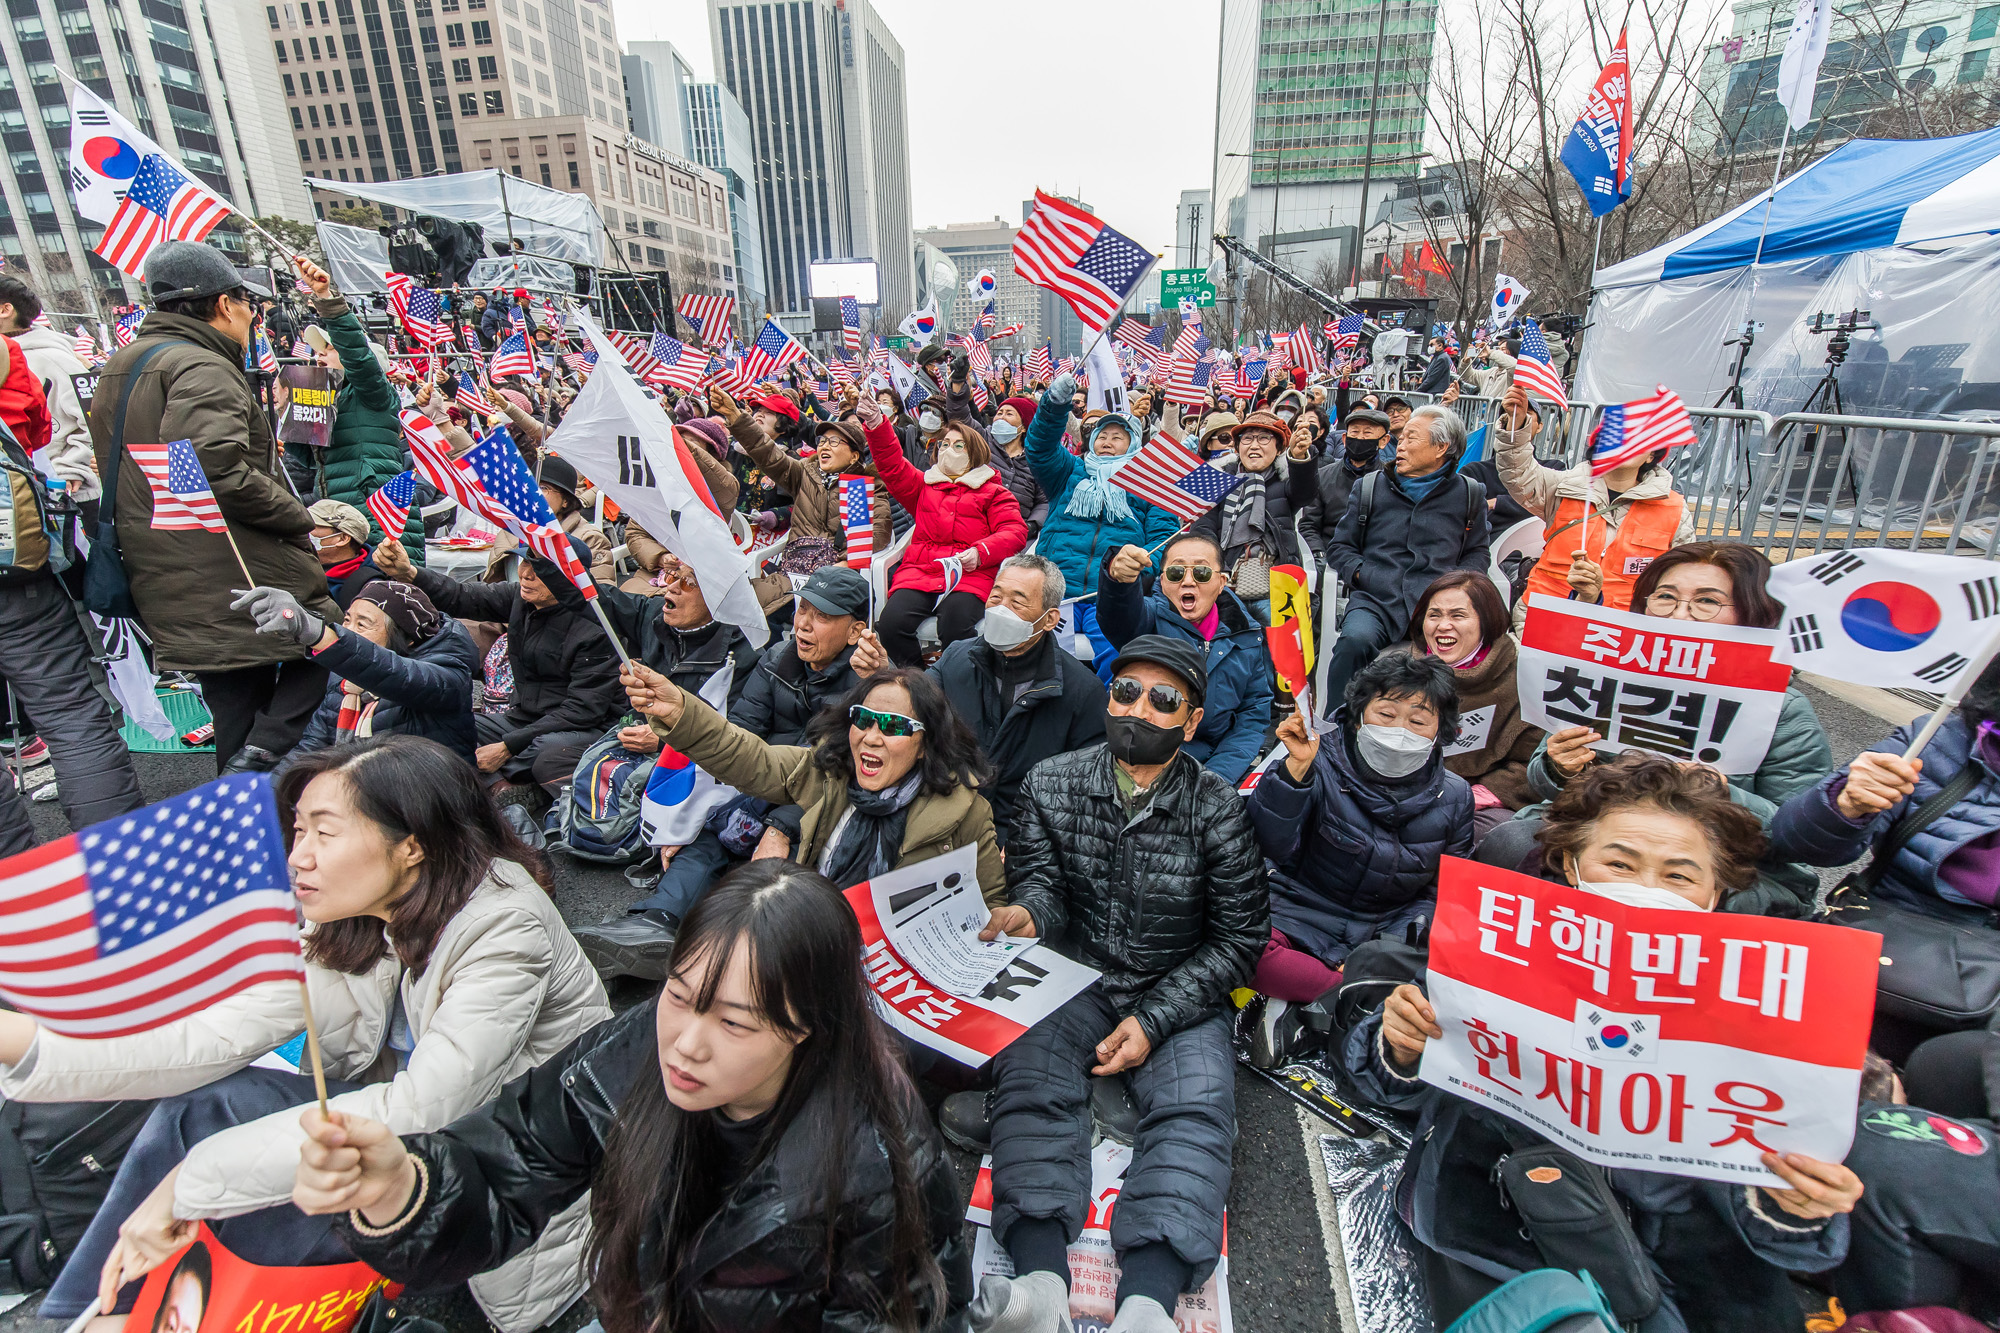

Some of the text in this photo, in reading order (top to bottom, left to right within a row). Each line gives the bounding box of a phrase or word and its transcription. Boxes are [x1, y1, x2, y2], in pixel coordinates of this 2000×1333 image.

[1573, 124, 1598, 152] SINCE 2003
[637, 140, 660, 160] SEOUL
[660, 149, 685, 170] FINANCE
[685, 160, 704, 176] CENTER
[1164, 286, 1183, 295] Jongno
[1580, 622, 1716, 680] 주사파
[1542, 665, 1743, 764] 척결!
[601, 787, 613, 819] MOUNTAIN
[1477, 885, 1810, 1022] 탄핵반대
[1463, 1017, 1789, 1154] 헌재아웃
[1070, 1267, 1113, 1284] 원천무효!
[1071, 1281, 1097, 1297] 해체!
